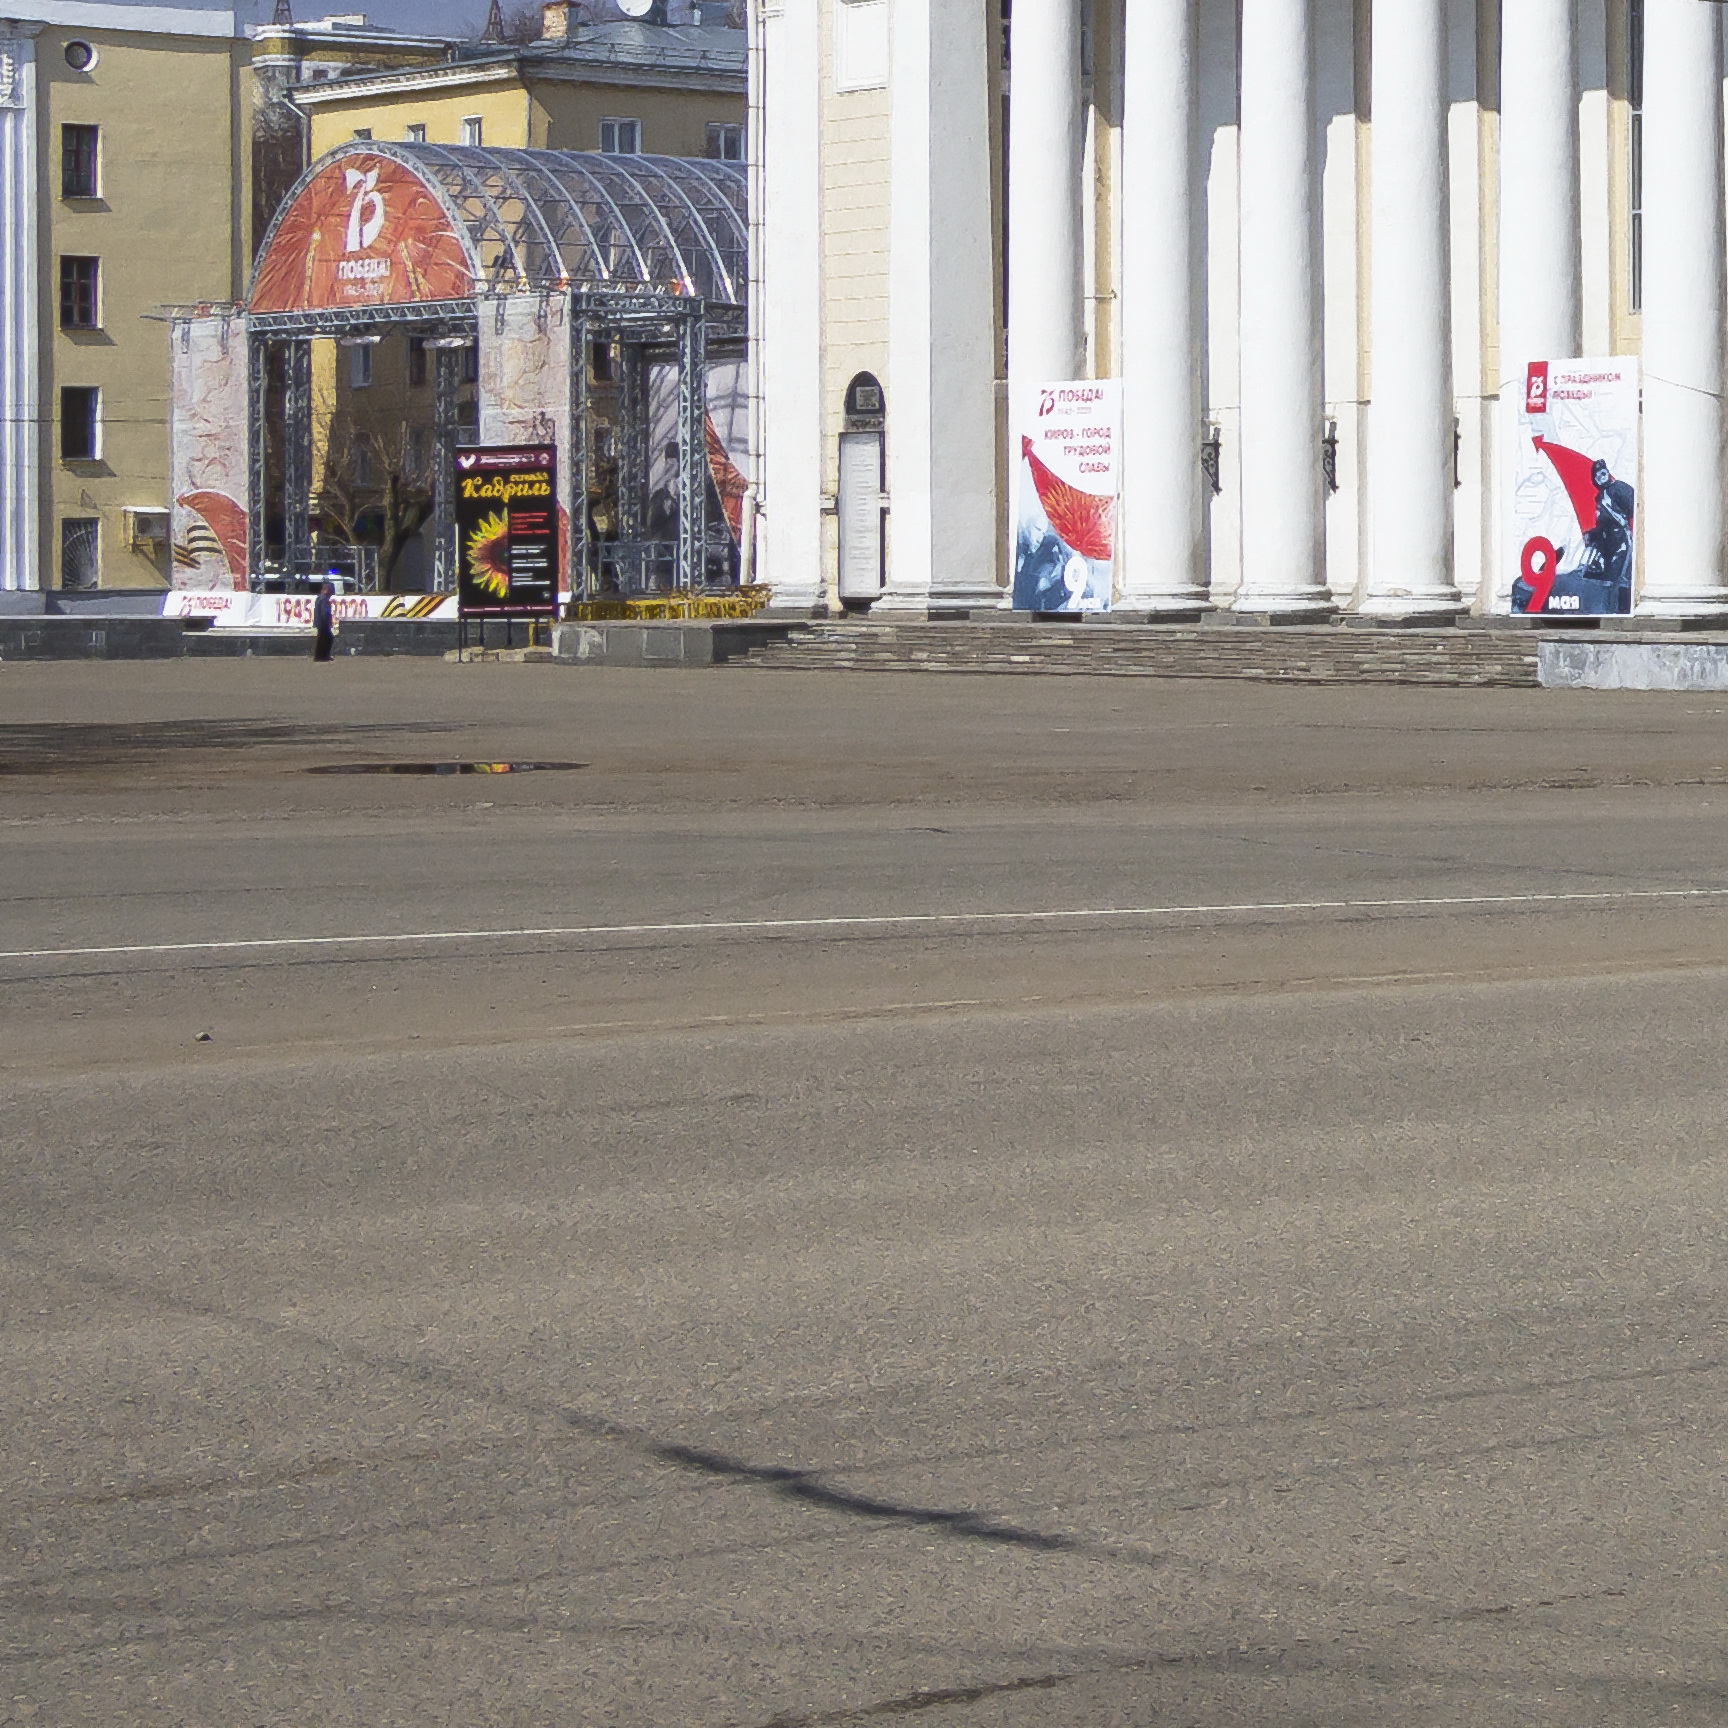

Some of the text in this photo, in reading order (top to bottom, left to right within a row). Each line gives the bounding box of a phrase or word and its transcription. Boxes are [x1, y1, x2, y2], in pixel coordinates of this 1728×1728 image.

[461, 475, 551, 504] Кадриль
[1063, 555, 1088, 609] 9
[1520, 535, 1557, 613] 9
[275, 597, 312, 624] 1945
